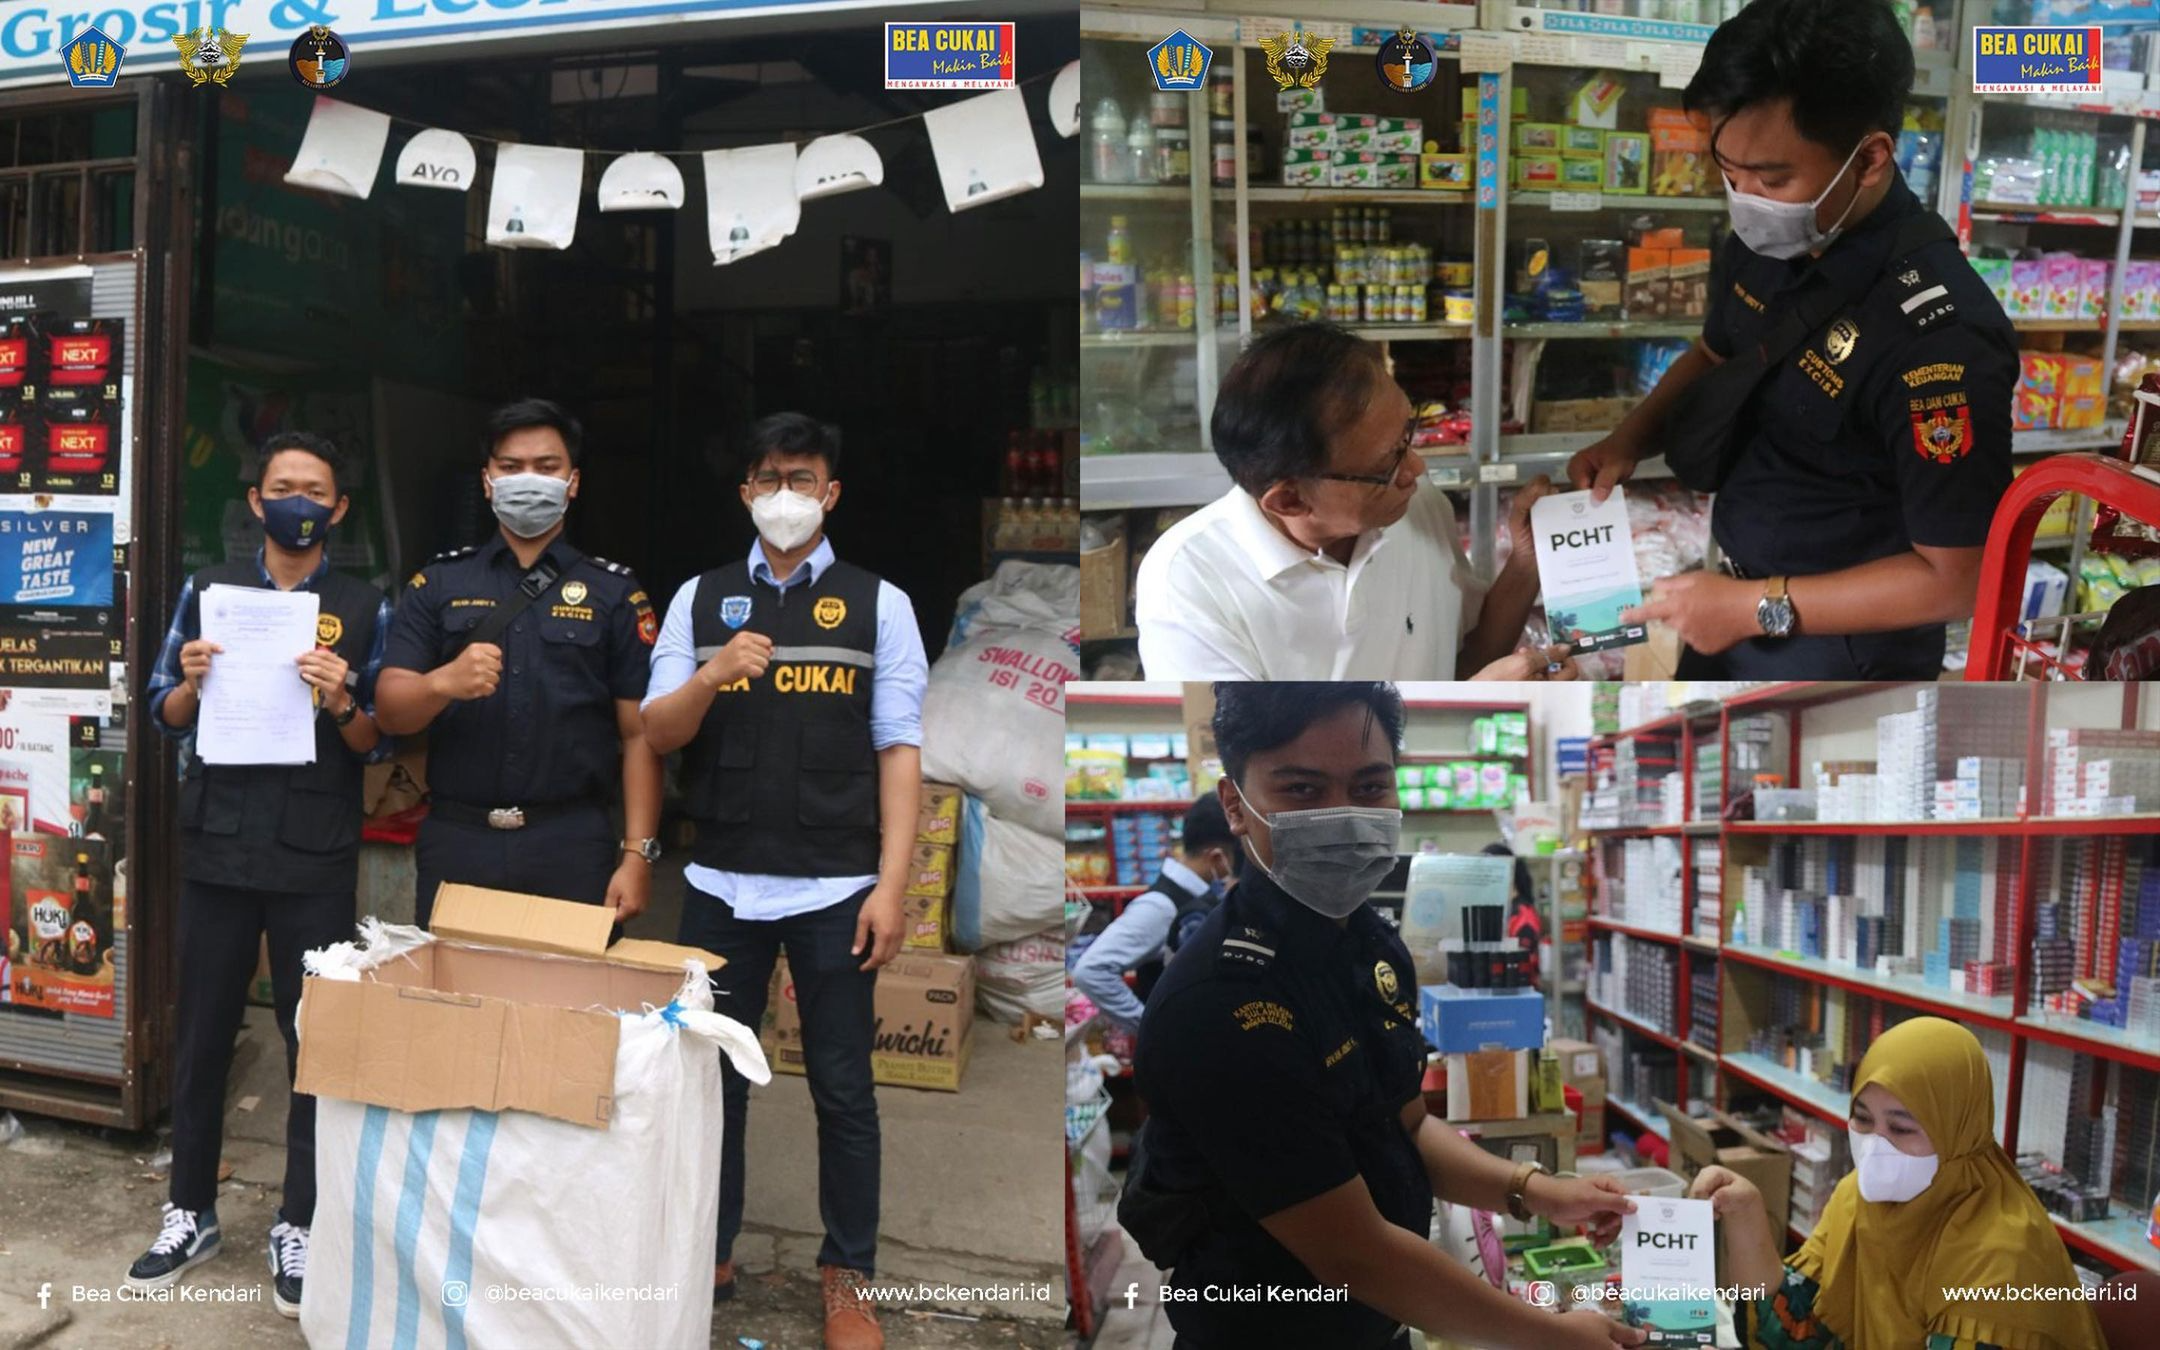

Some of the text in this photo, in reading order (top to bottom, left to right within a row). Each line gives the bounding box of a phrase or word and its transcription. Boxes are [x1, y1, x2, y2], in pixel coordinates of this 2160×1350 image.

[411, 162, 460, 183] AYO
[62, 348, 99, 362] NEXT
[1798, 358, 1840, 399] EXCISE
[1804, 349, 1845, 390] CUSTOMS
[1901, 363, 1965, 383] KEMENTERIAN
[105, 384, 118, 395] 12
[60, 436, 97, 449] NEXT
[102, 473, 115, 483] 12
[1, 520, 89, 534] SILVER
[22, 537, 58, 555] NEW
[1550, 524, 1615, 552] PCHT
[21, 549, 75, 572] GREAT
[21, 568, 72, 590] TASTE
[109, 639, 122, 650] 12
[9, 658, 105, 675] TERGANTIKAN
[978, 646, 1080, 686] SWALLOW
[774, 664, 857, 695] CUKAI
[988, 669, 1059, 706] ISI 20
[82, 725, 95, 736] 12
[34, 906, 68, 930] HUKI
[1637, 1231, 1699, 1251] PCHT
